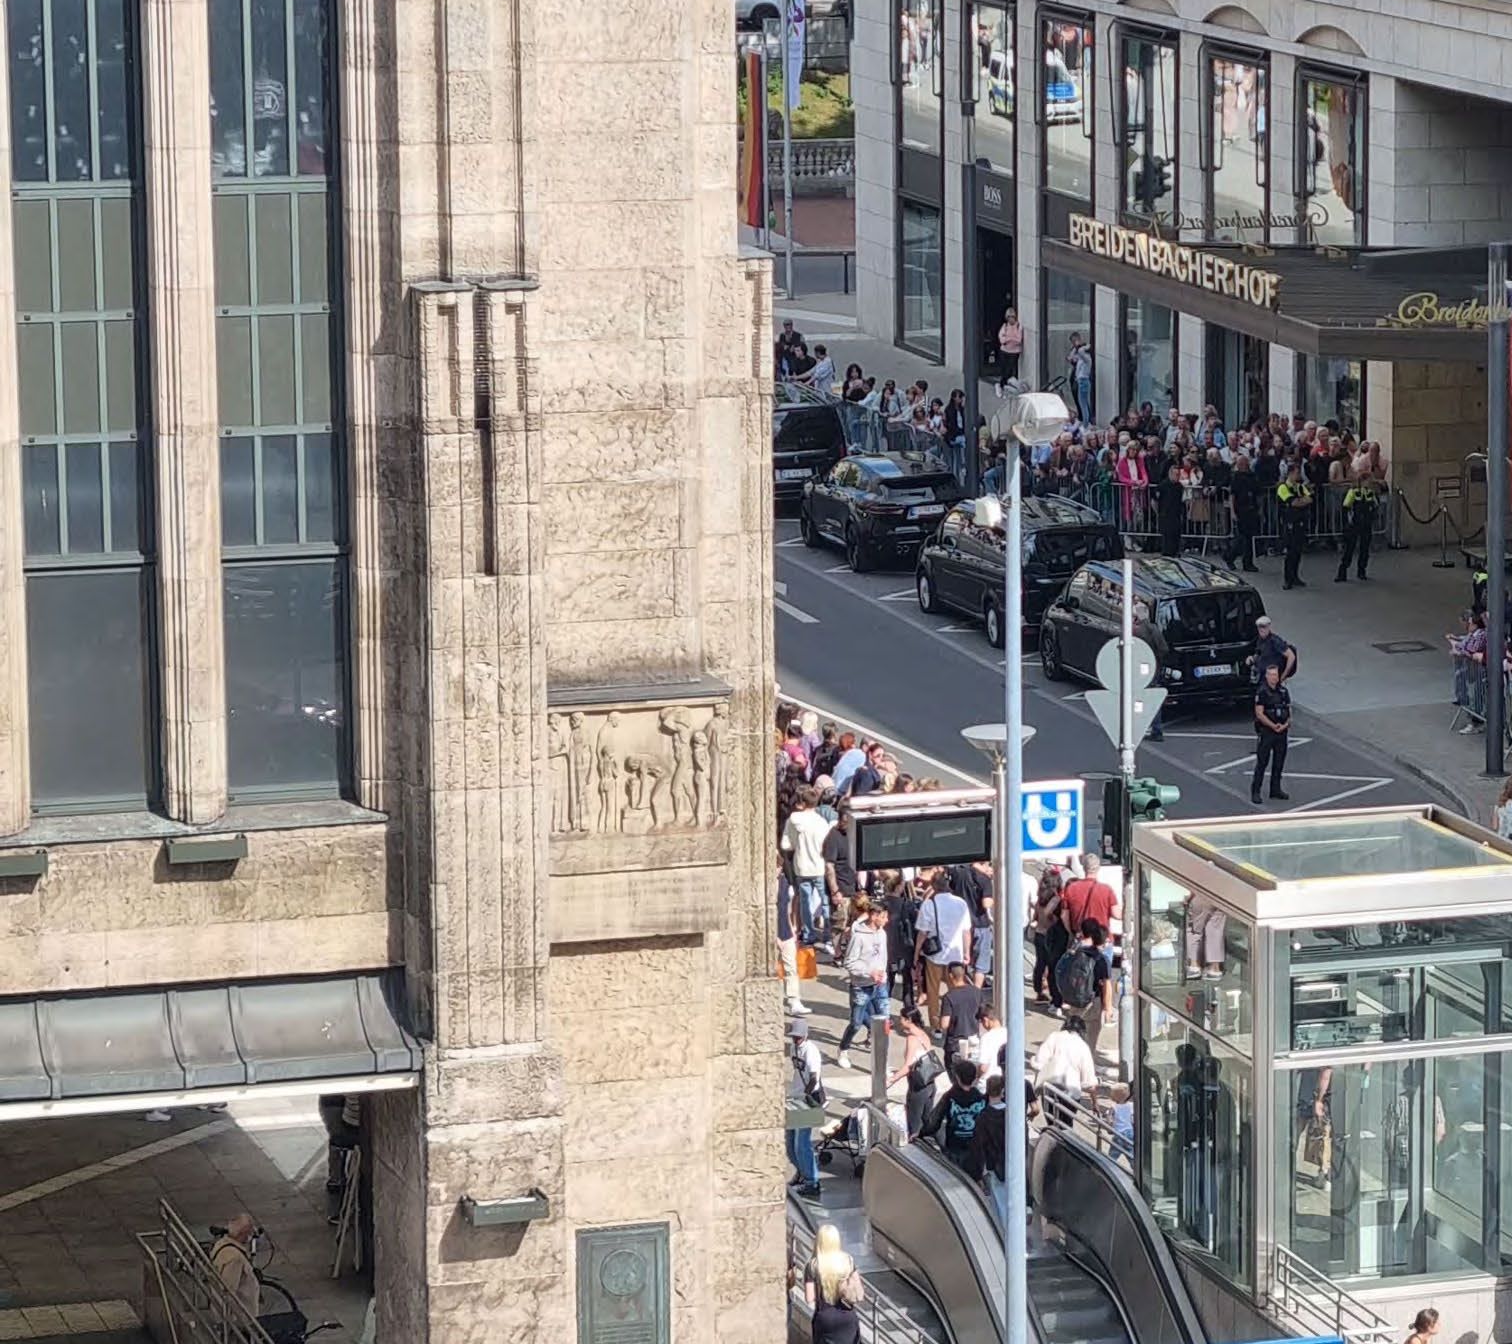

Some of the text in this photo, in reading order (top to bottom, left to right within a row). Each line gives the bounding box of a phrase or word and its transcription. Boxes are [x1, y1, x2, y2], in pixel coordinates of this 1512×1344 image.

[1069, 212, 1231, 295] BREIDENBACHER
[1233, 262, 1282, 309] HOF
[1026, 791, 1072, 848] U
